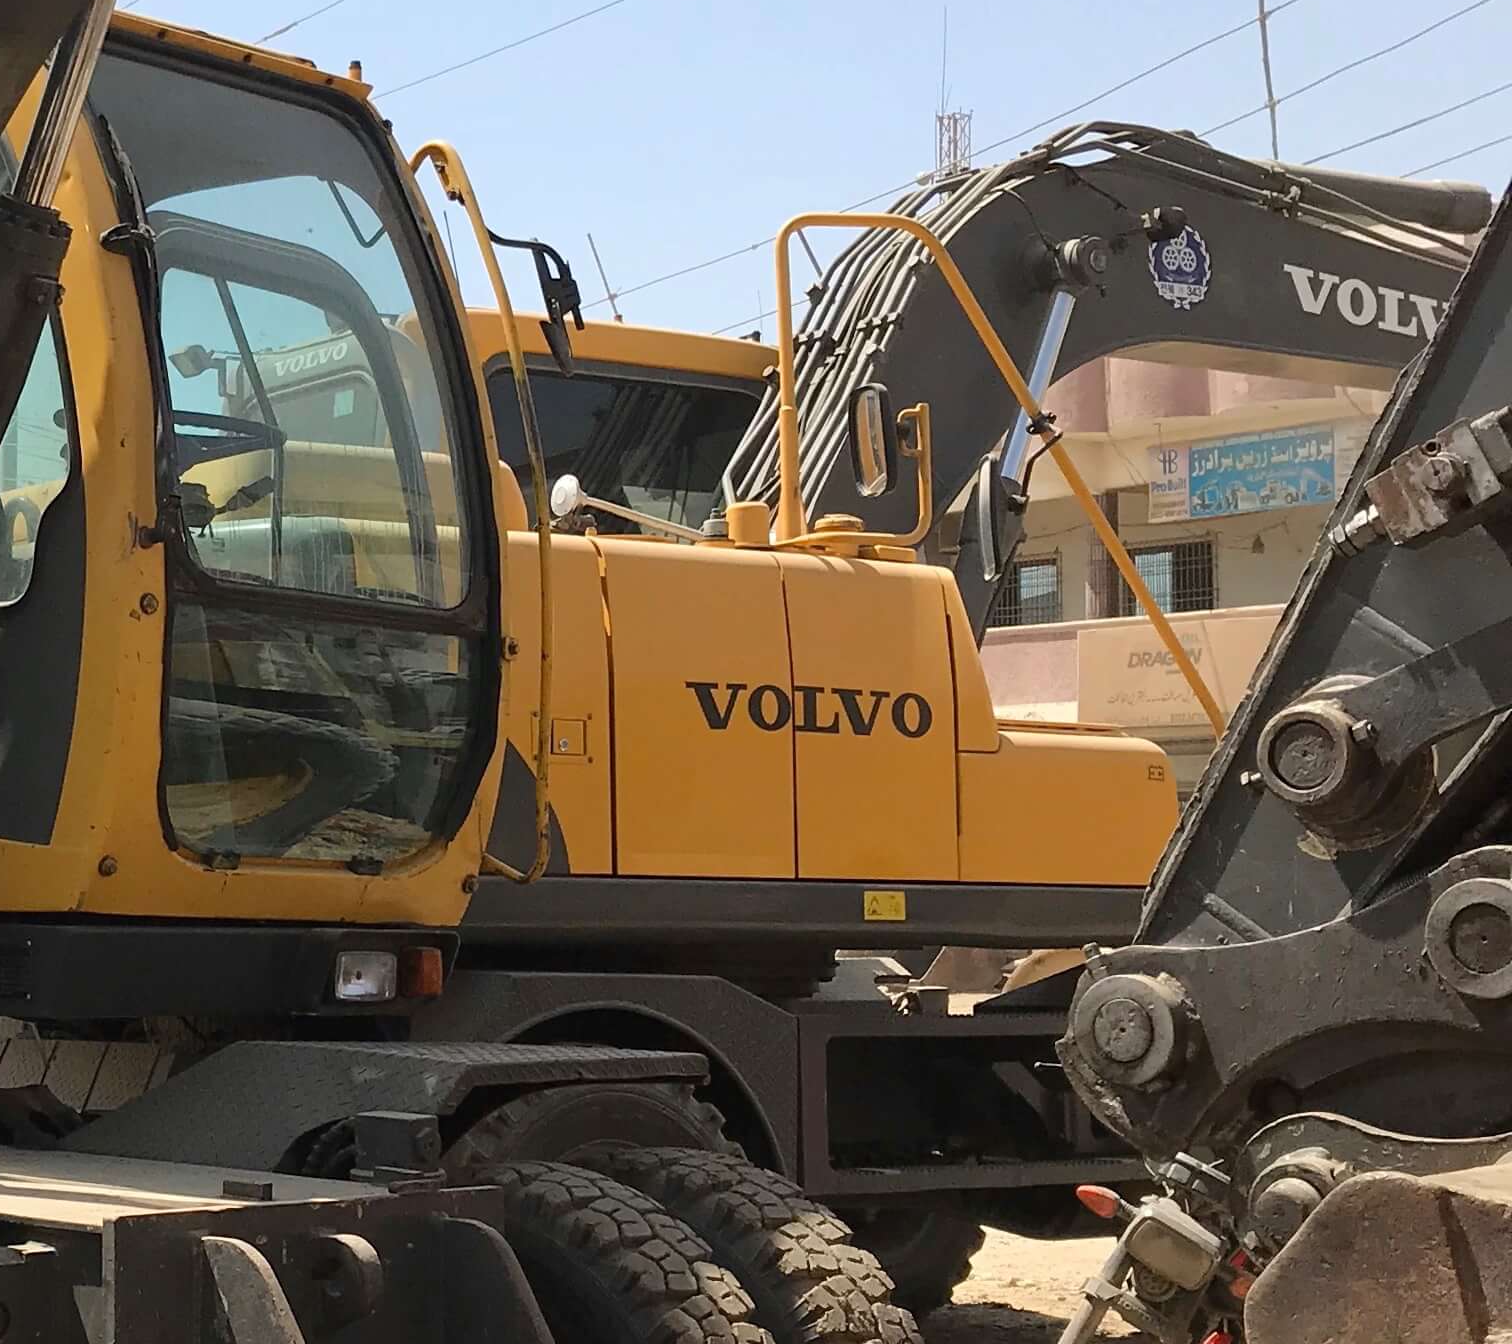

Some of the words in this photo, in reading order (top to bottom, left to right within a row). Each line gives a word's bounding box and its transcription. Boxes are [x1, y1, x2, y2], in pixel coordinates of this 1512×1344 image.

[1283, 263, 1450, 341] VOLV
[274, 342, 348, 377] VOLVO
[1127, 647, 1202, 669] DRAGN
[685, 681, 933, 738] VOLVO
